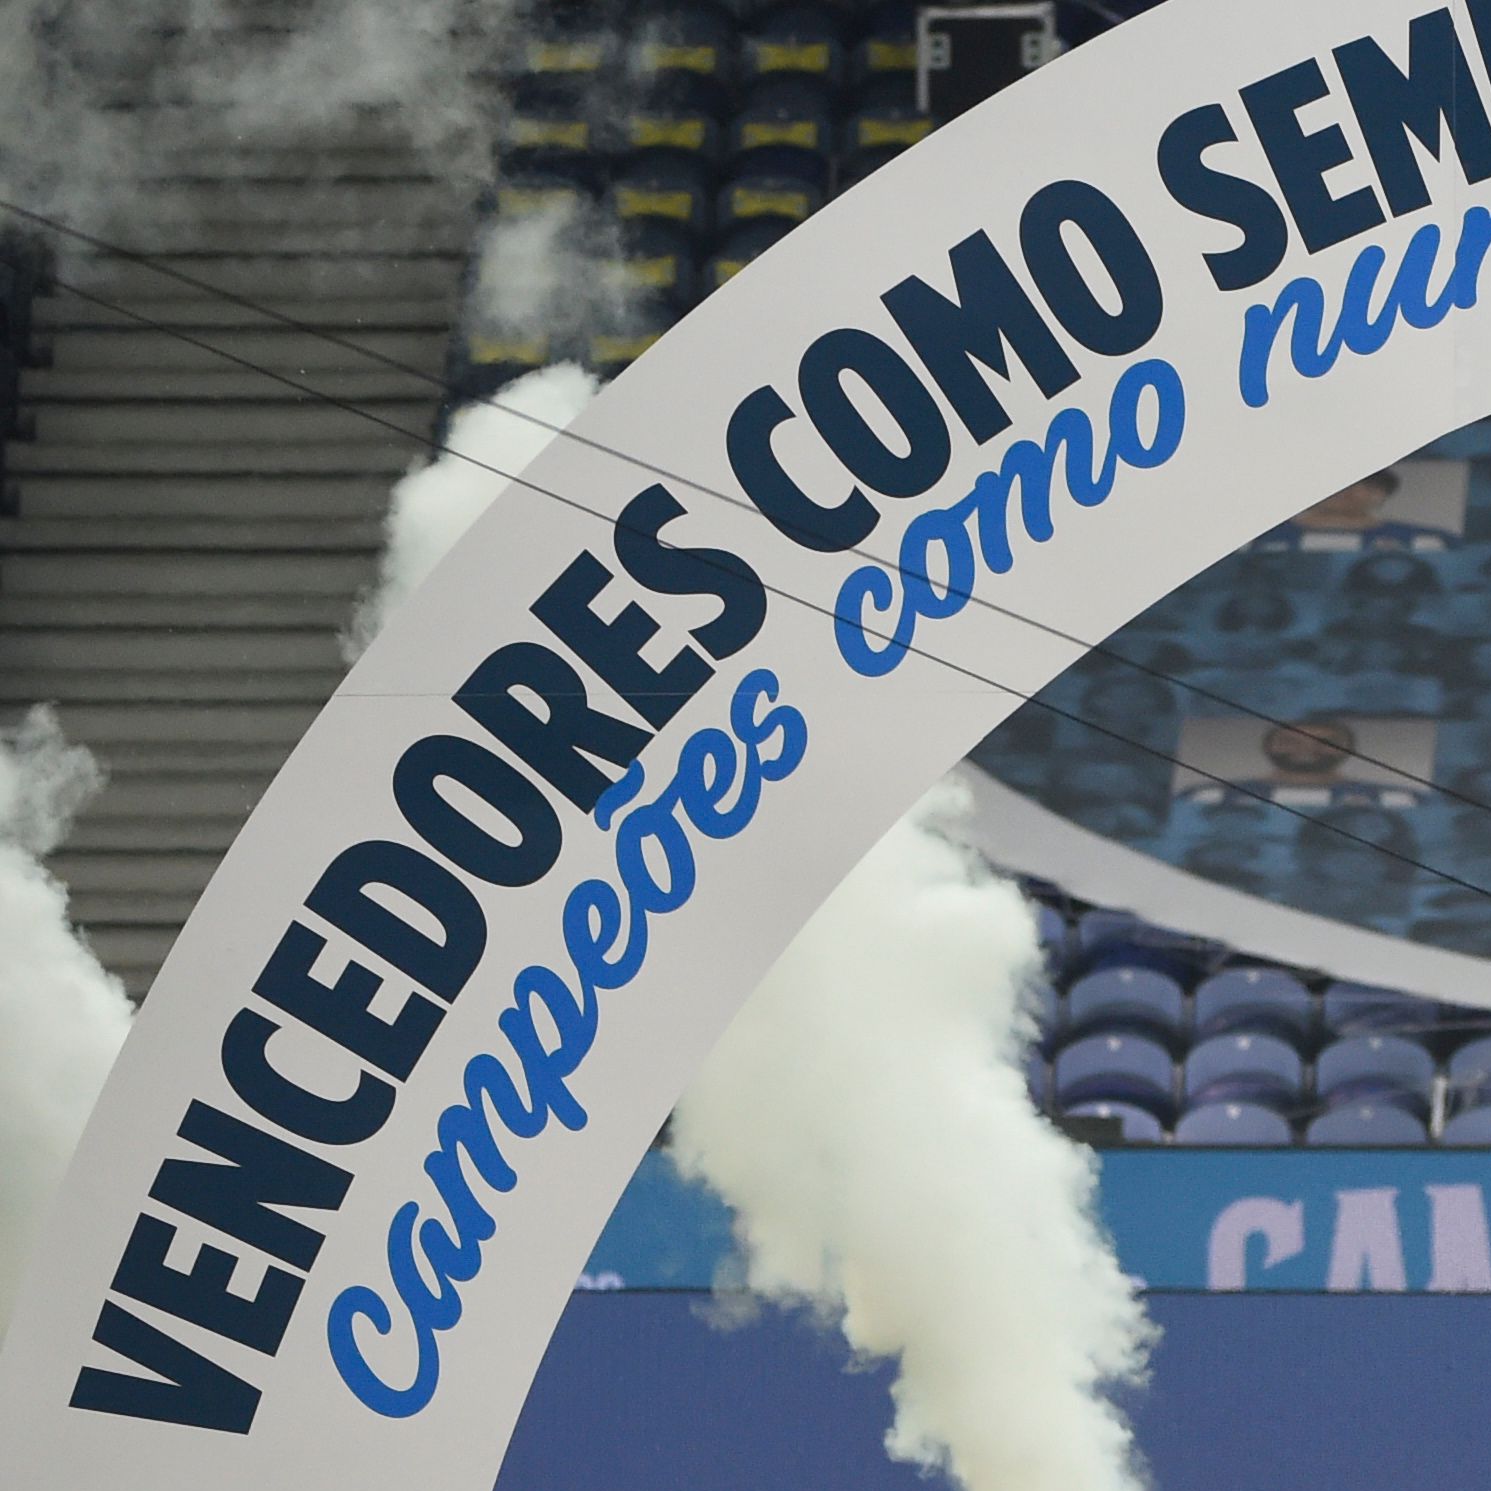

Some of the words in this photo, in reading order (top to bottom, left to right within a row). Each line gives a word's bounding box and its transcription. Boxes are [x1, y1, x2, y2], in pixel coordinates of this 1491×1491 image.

[70, 482, 767, 1435] VENCEDORES
[726, 178, 1164, 551] COMO
[833, 358, 1186, 678] como
